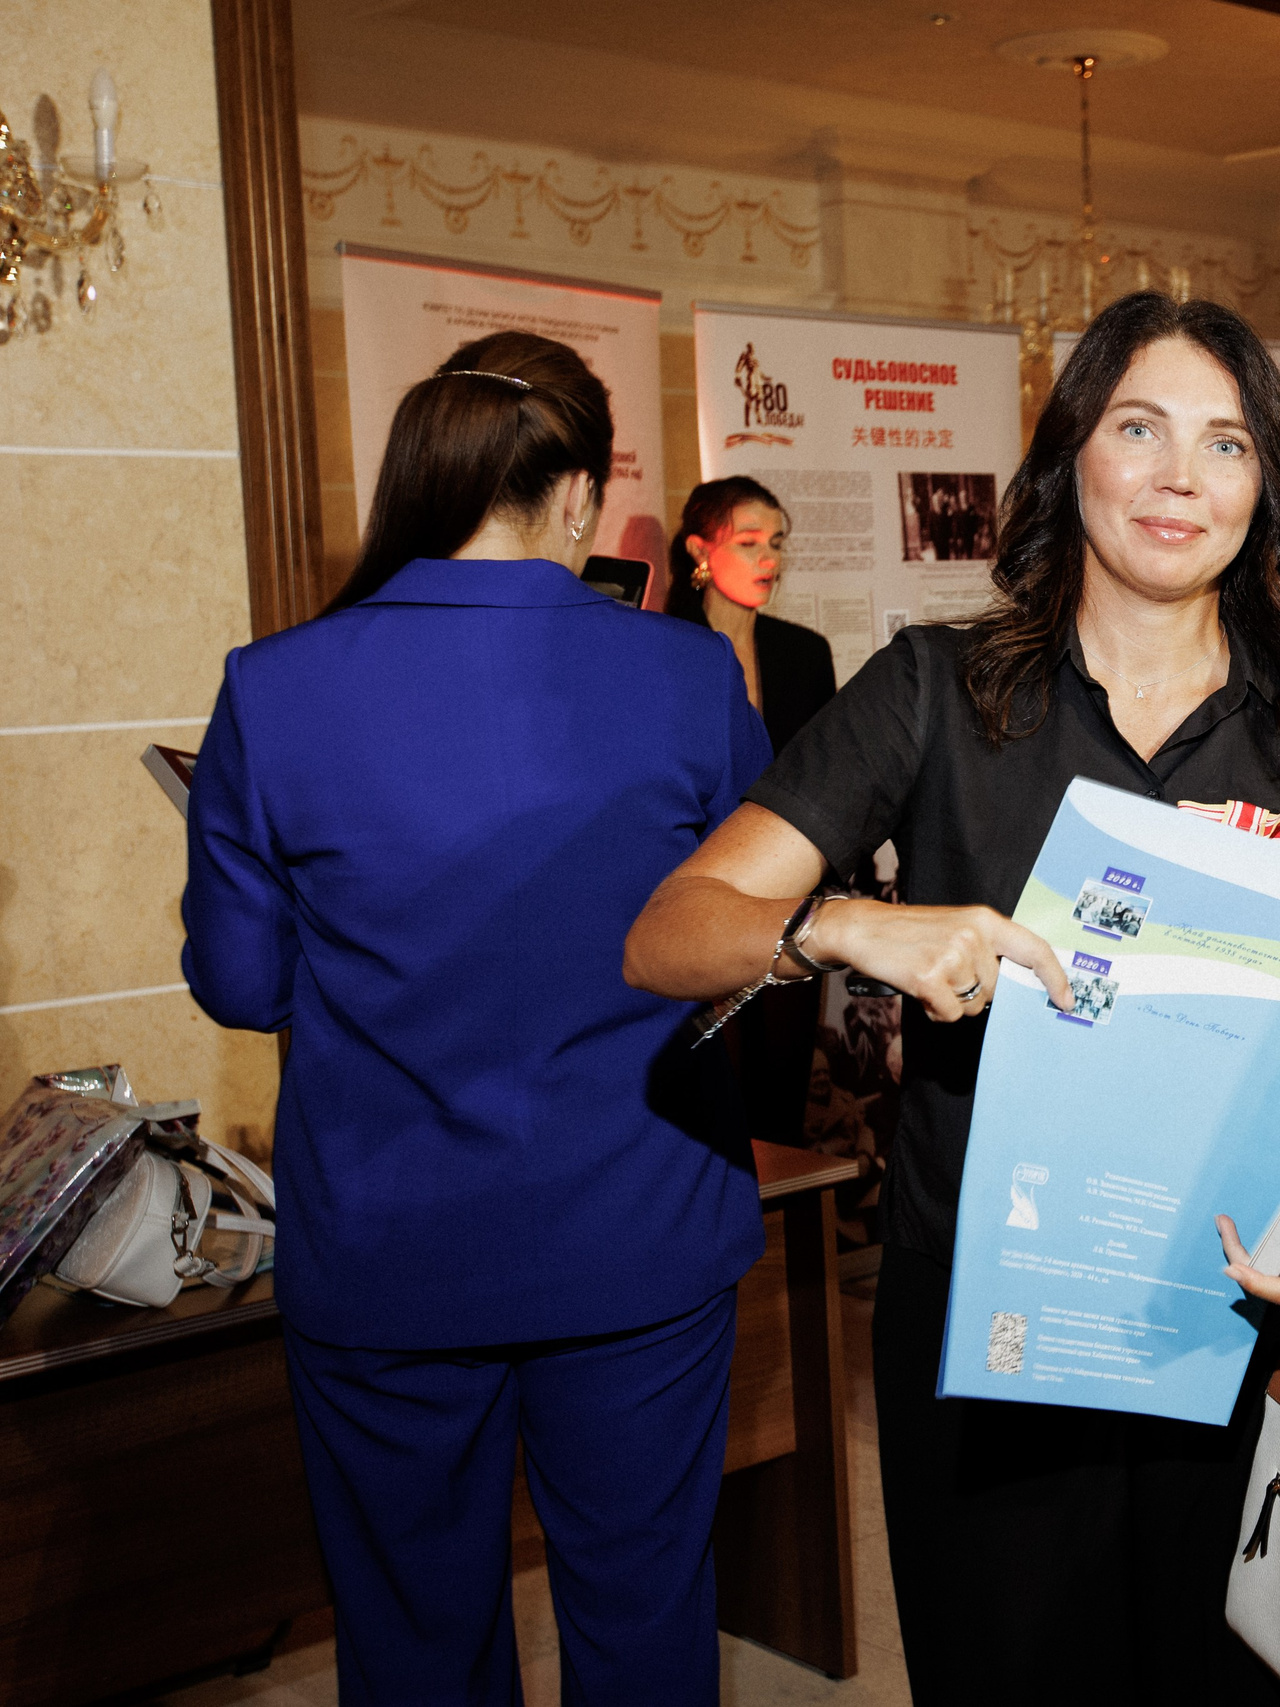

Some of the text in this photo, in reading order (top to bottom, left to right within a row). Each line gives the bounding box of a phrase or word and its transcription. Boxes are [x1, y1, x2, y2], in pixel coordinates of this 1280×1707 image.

[831, 357, 958, 386] СУДЬБОНОСНОЕ
[763, 383, 788, 412] 80
[864, 388, 935, 412] РЕШЕНИЕ
[852, 427, 953, 449] 关键性的决定
[1106, 872, 1132, 886] 2019
[1075, 957, 1099, 970] 2020
[1176, 1013, 1200, 1027] День
